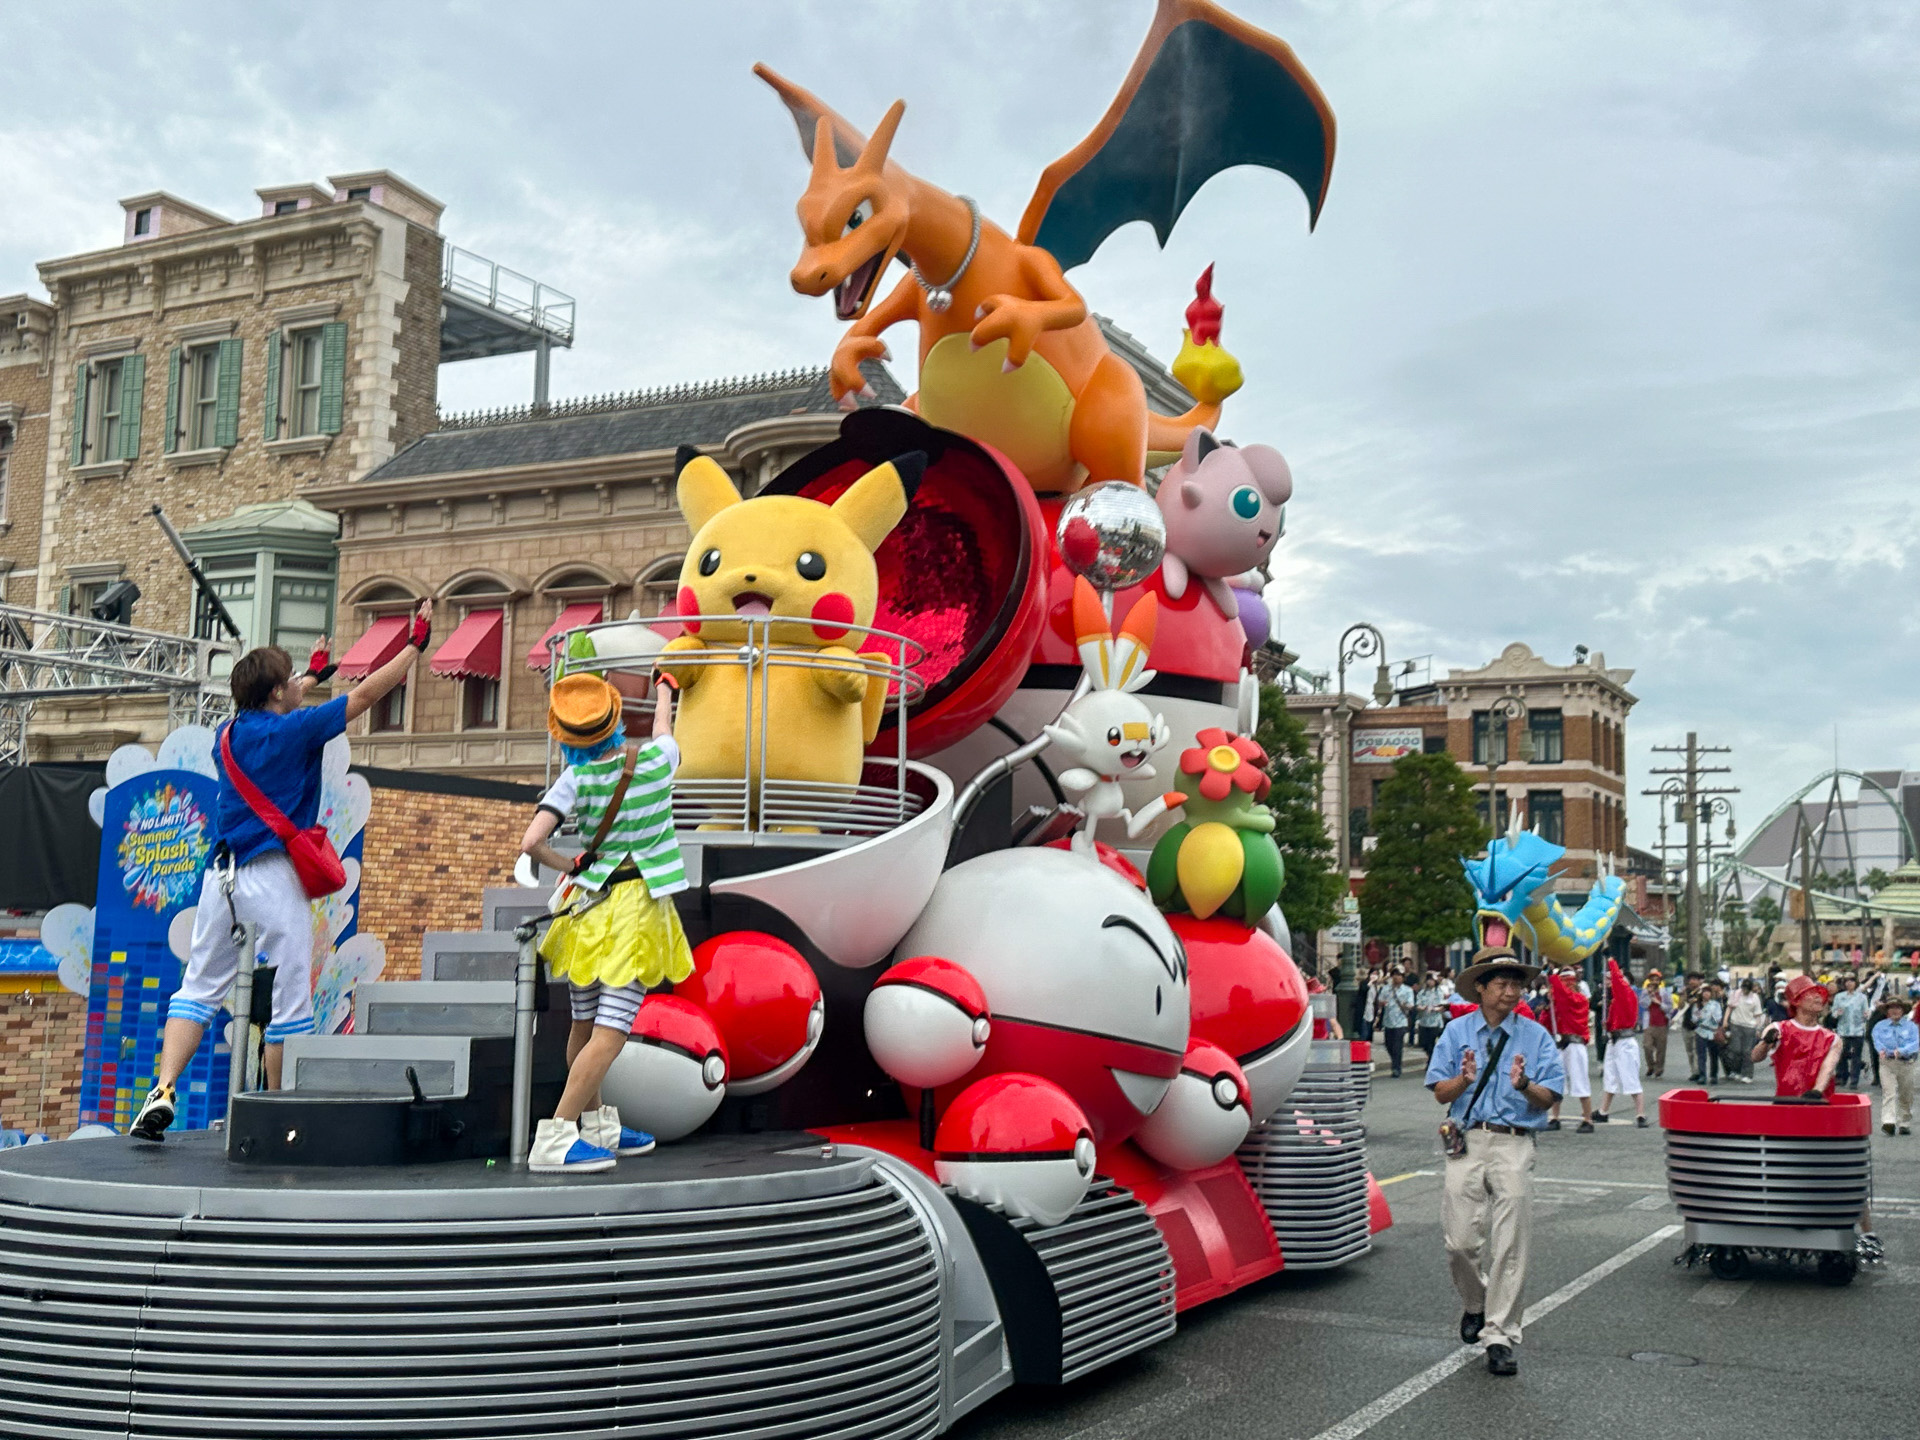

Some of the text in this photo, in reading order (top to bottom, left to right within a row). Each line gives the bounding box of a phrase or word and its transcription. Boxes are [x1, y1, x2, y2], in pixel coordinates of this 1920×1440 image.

[1355, 737, 1420, 746] TOBACCO
[141, 813, 184, 830] NO LIMIT!
[130, 829, 178, 847] Summer
[136, 839, 189, 868] Splash
[152, 859, 196, 877] Parade
